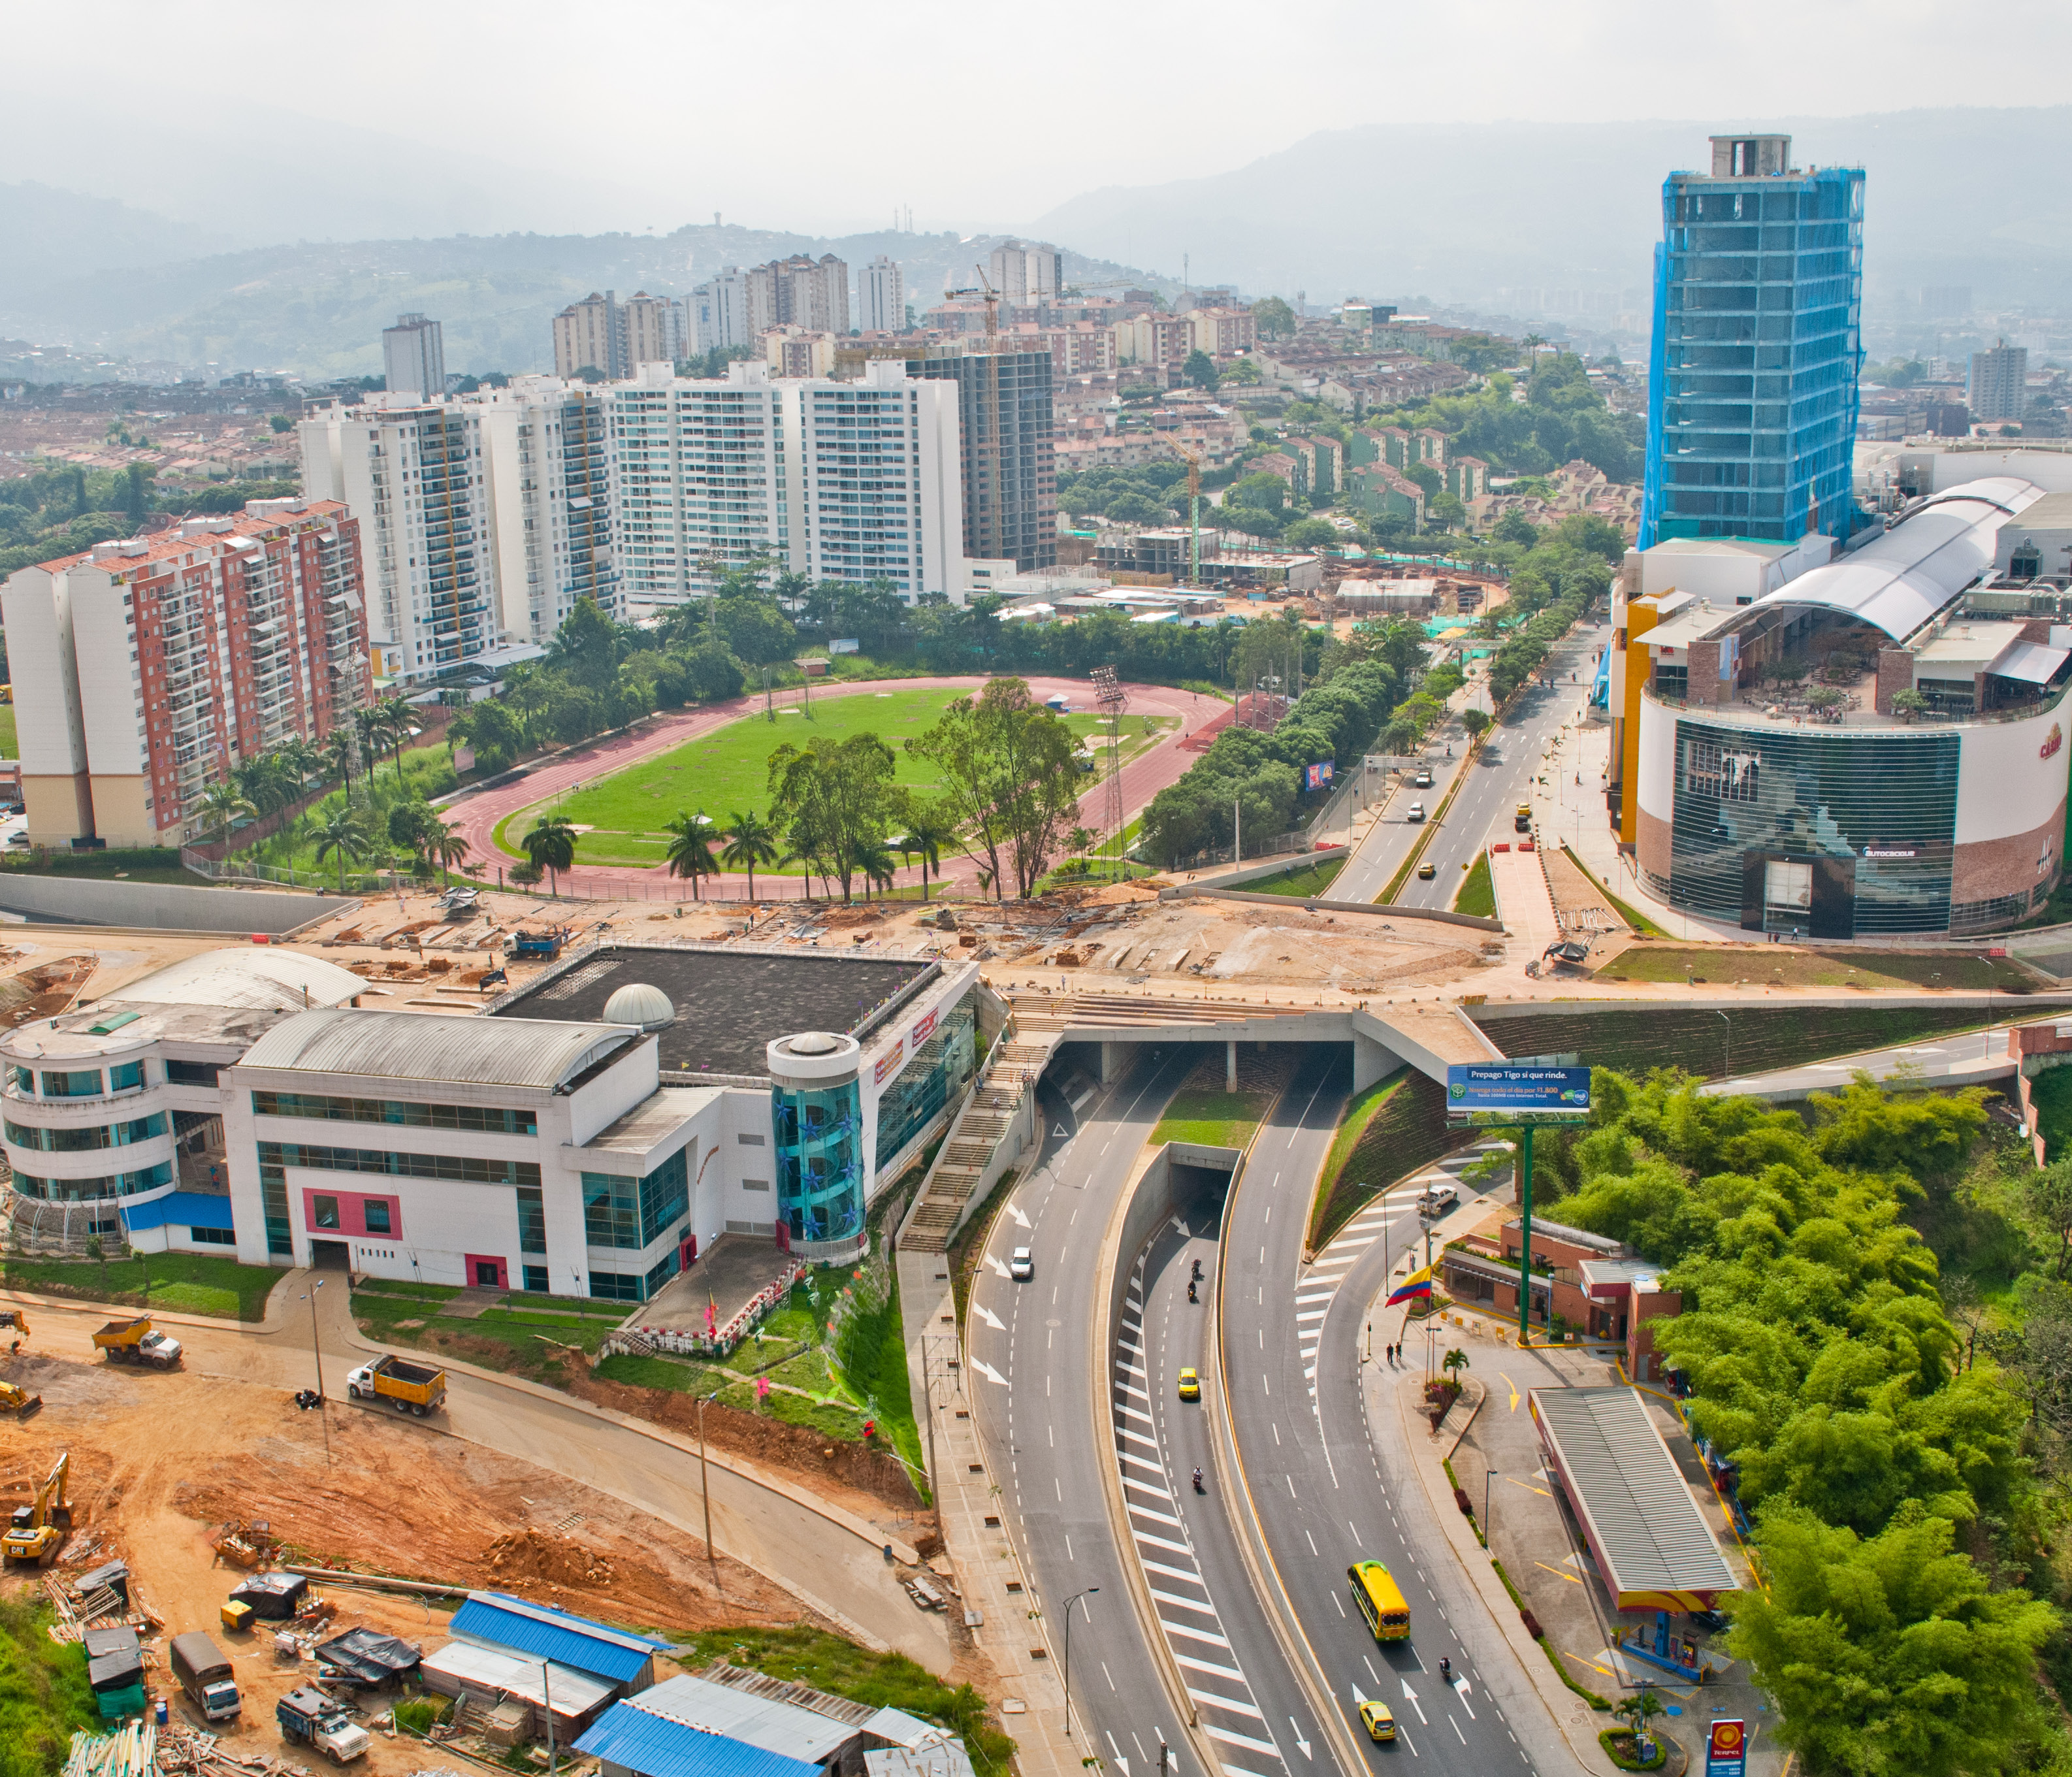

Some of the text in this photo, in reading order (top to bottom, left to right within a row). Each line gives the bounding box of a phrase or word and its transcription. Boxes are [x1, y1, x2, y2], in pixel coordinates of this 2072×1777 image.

[1471, 1071, 1502, 1080] Prepago
[1504, 1071, 1521, 1080] Tigo
[11, 1546, 25, 1555] CAT
